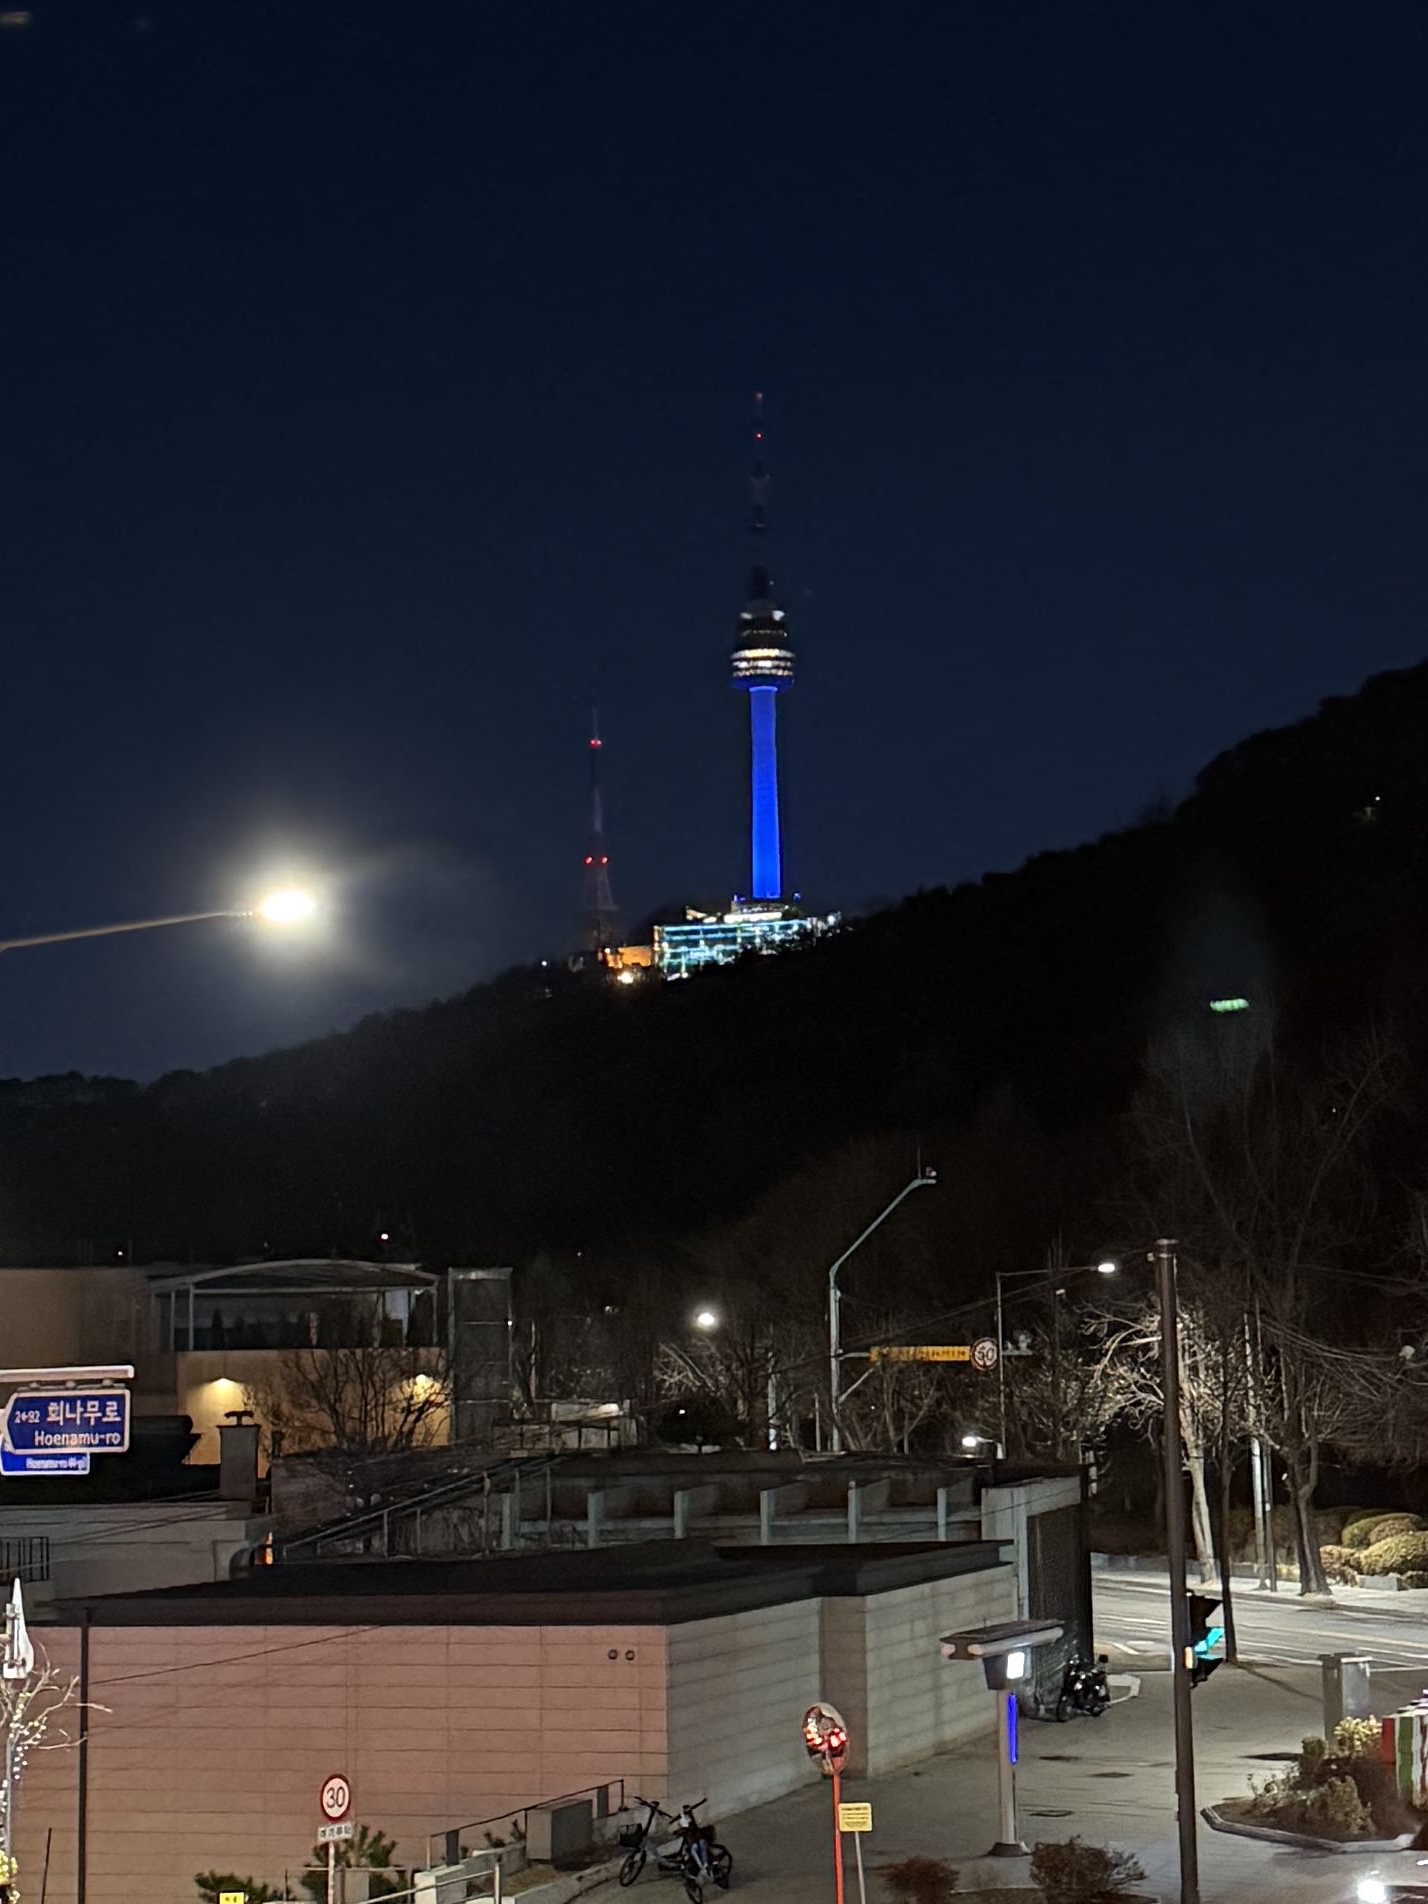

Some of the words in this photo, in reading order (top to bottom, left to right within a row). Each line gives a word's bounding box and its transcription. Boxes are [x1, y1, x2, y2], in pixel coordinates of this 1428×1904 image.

[46, 1399, 122, 1426] 회나무로
[34, 1430, 122, 1446] Hoenamu-ro
[326, 1786, 346, 1809] 30
